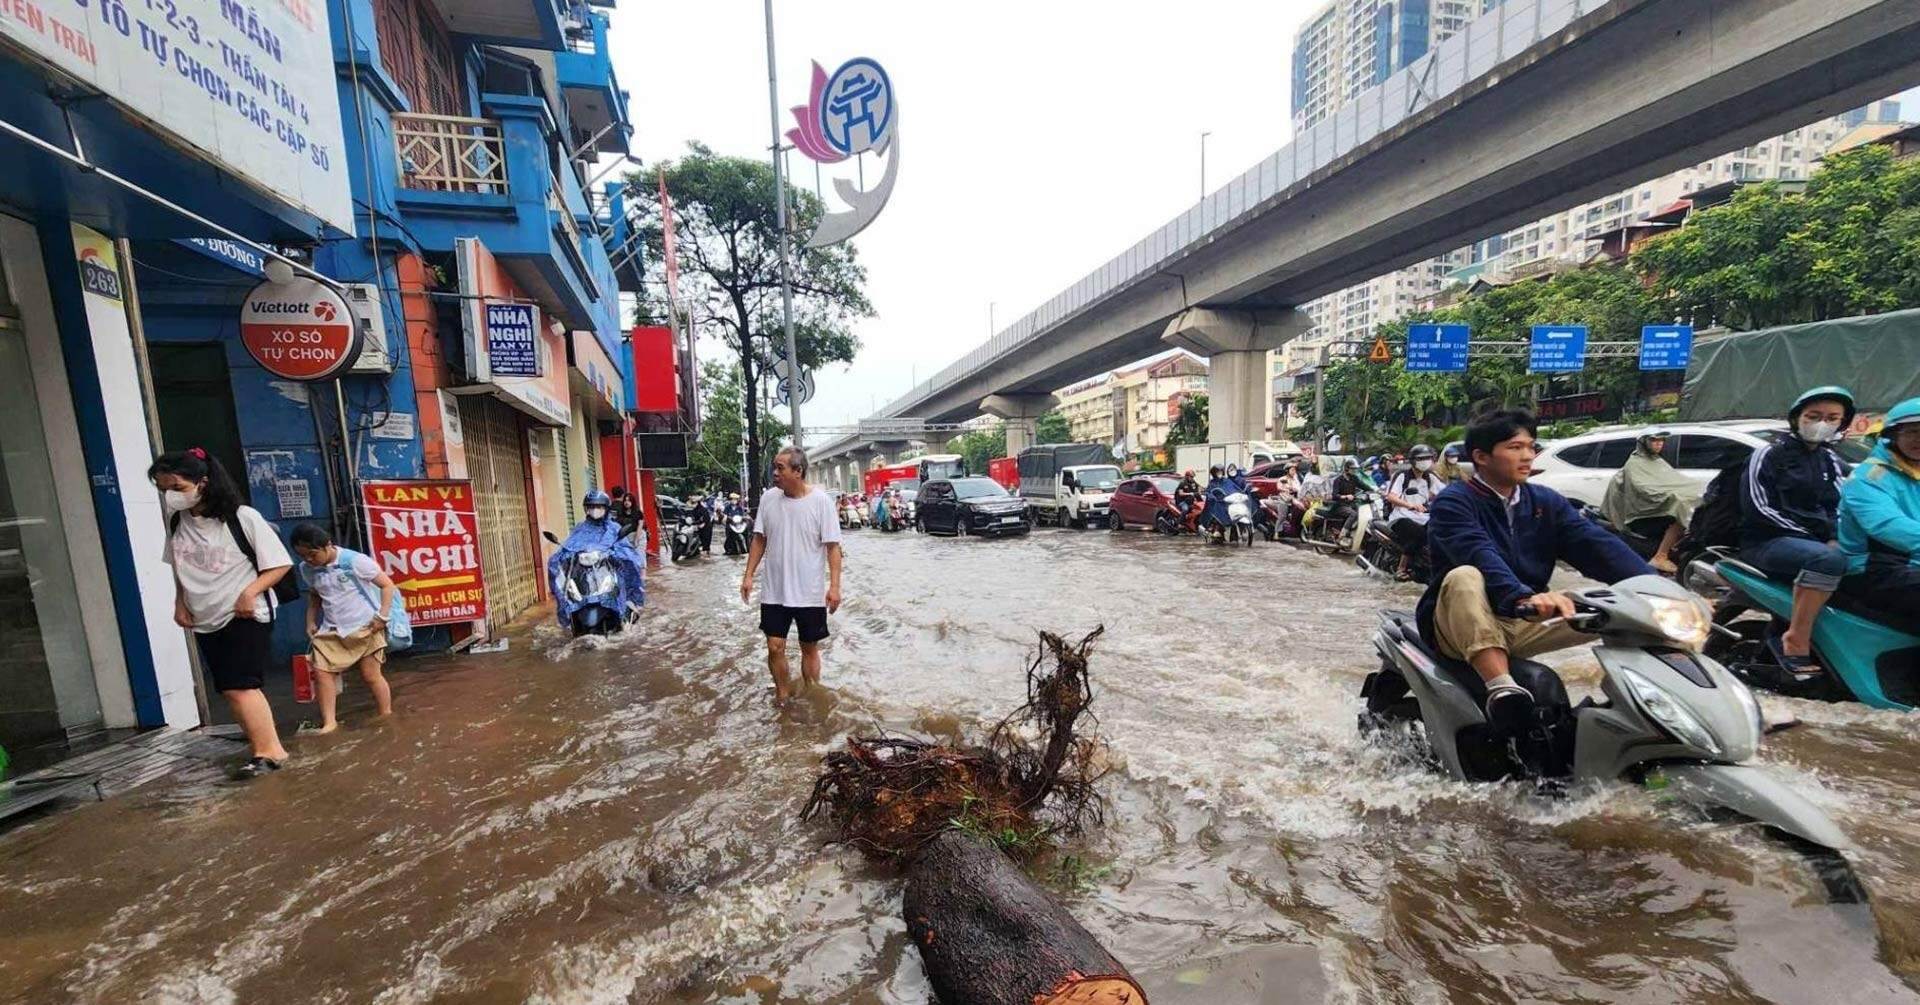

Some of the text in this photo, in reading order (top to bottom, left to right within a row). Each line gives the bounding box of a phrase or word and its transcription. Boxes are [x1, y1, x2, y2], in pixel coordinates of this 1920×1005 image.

[136, 19, 168, 66] TỰ
[174, 47, 232, 106] CHỌN
[236, 92, 272, 133] CÁC
[276, 119, 306, 154] CẶP
[310, 144, 329, 172] SỐ
[300, 103, 309, 125] 4
[86, 267, 118, 295] 263
[251, 301, 310, 314] Vietlott
[489, 308, 530, 325] NHÀ
[288, 348, 336, 362] CHỌN
[492, 342, 532, 350] LAN VI
[375, 486, 463, 502] LAN VI
[380, 502, 467, 539] NHÀ
[380, 534, 479, 576] NGHỈ
